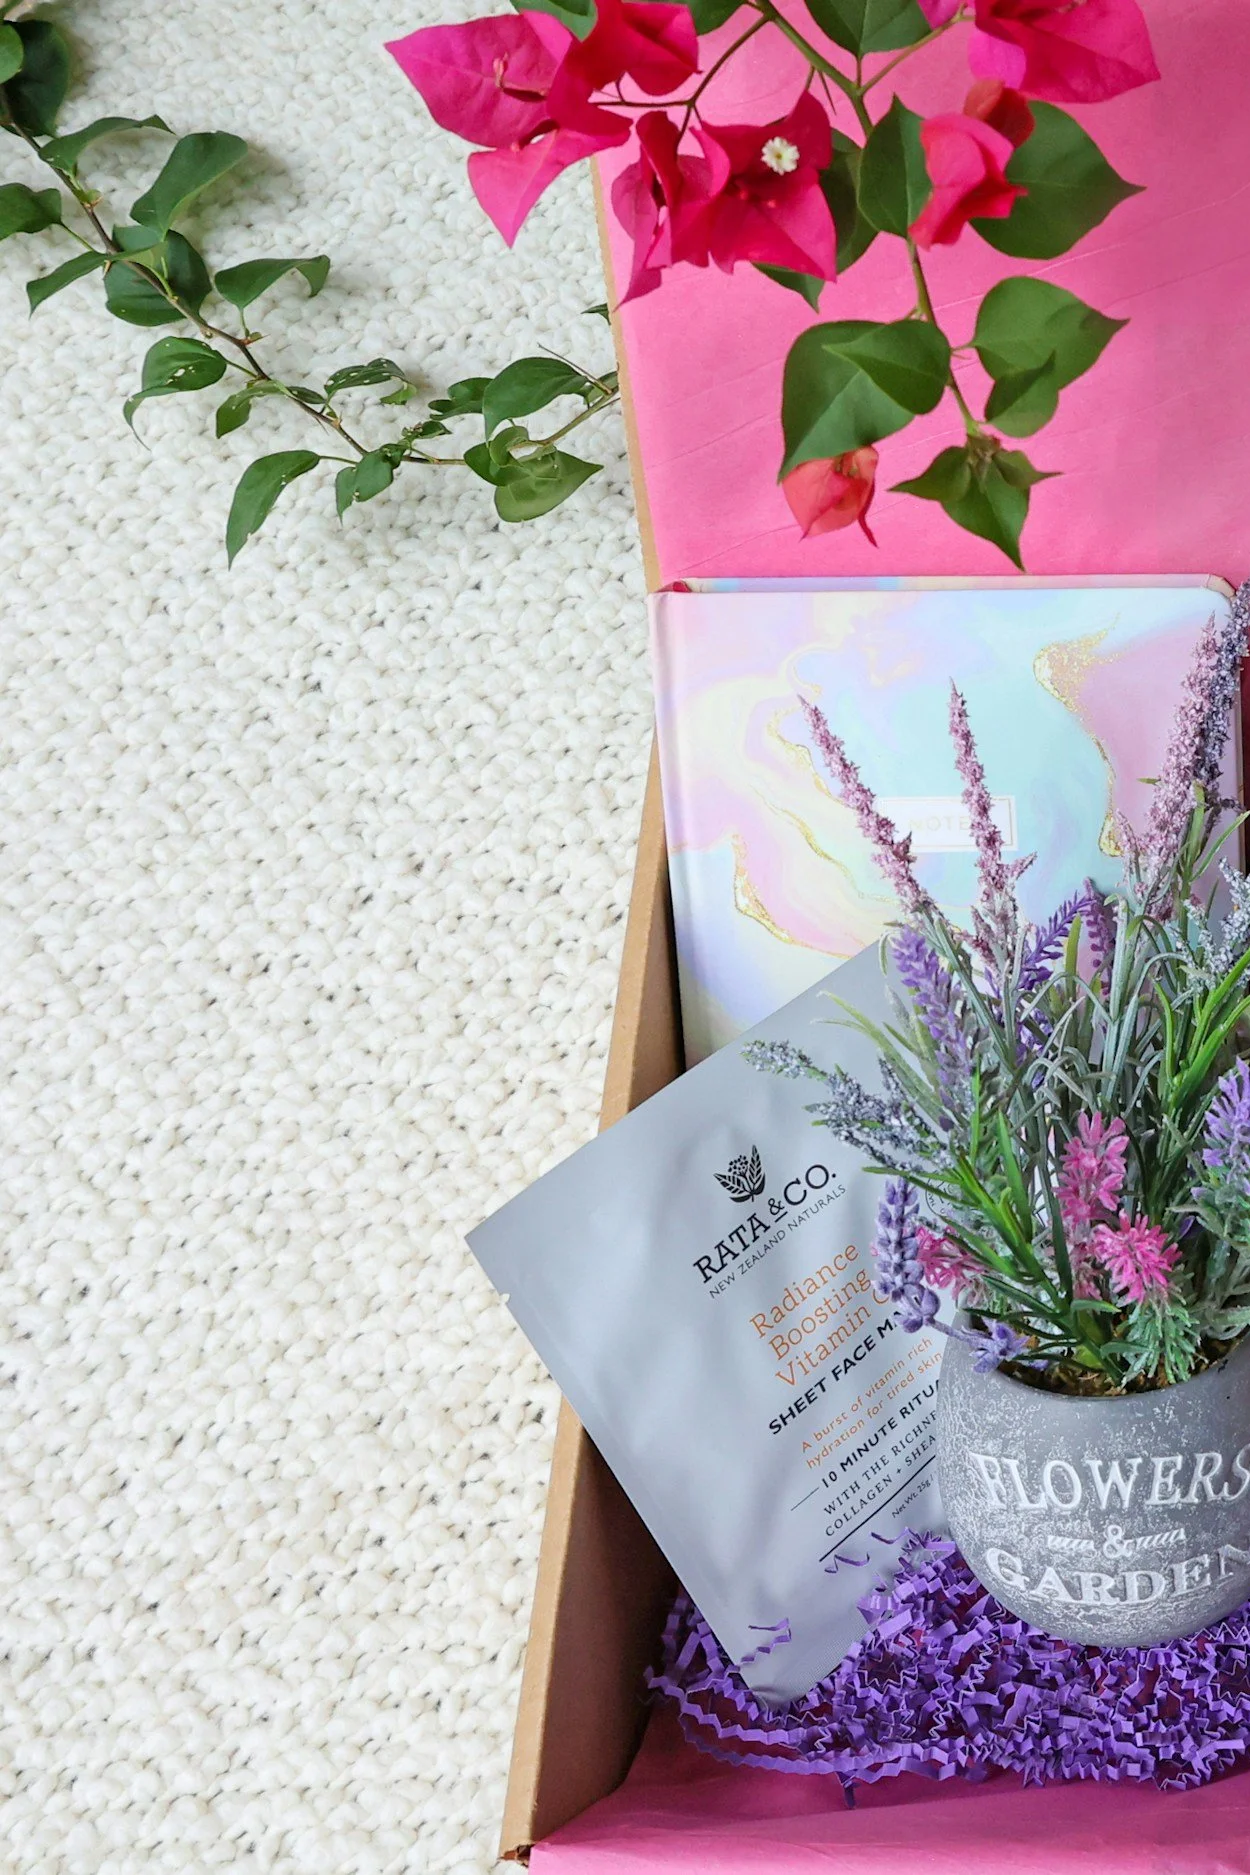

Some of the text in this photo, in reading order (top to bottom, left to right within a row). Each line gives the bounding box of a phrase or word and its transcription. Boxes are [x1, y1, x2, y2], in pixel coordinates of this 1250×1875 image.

[908, 815, 970, 832] NOTE
[693, 1164, 836, 1284] RATA & CO.
[709, 1184, 846, 1299] NEW ZEALAND NATURALS
[749, 1244, 860, 1339] Radiance
[768, 1268, 872, 1360] Boosting
[768, 1335, 877, 1435] SHEET FACE
[775, 1305, 871, 1386] Vitamin
[802, 1338, 933, 1452] A burst of vitamin rich
[806, 1352, 943, 1469] hydration for tired skin
[822, 1379, 940, 1488] 10 MINUTE RITU
[823, 1410, 938, 1515] WITH THE RICHNE
[825, 1474, 893, 1537] COLLAGEN
[904, 1434, 937, 1467] SHEA
[891, 1503, 906, 1519] Net
[1101, 1525, 1133, 1558] &
